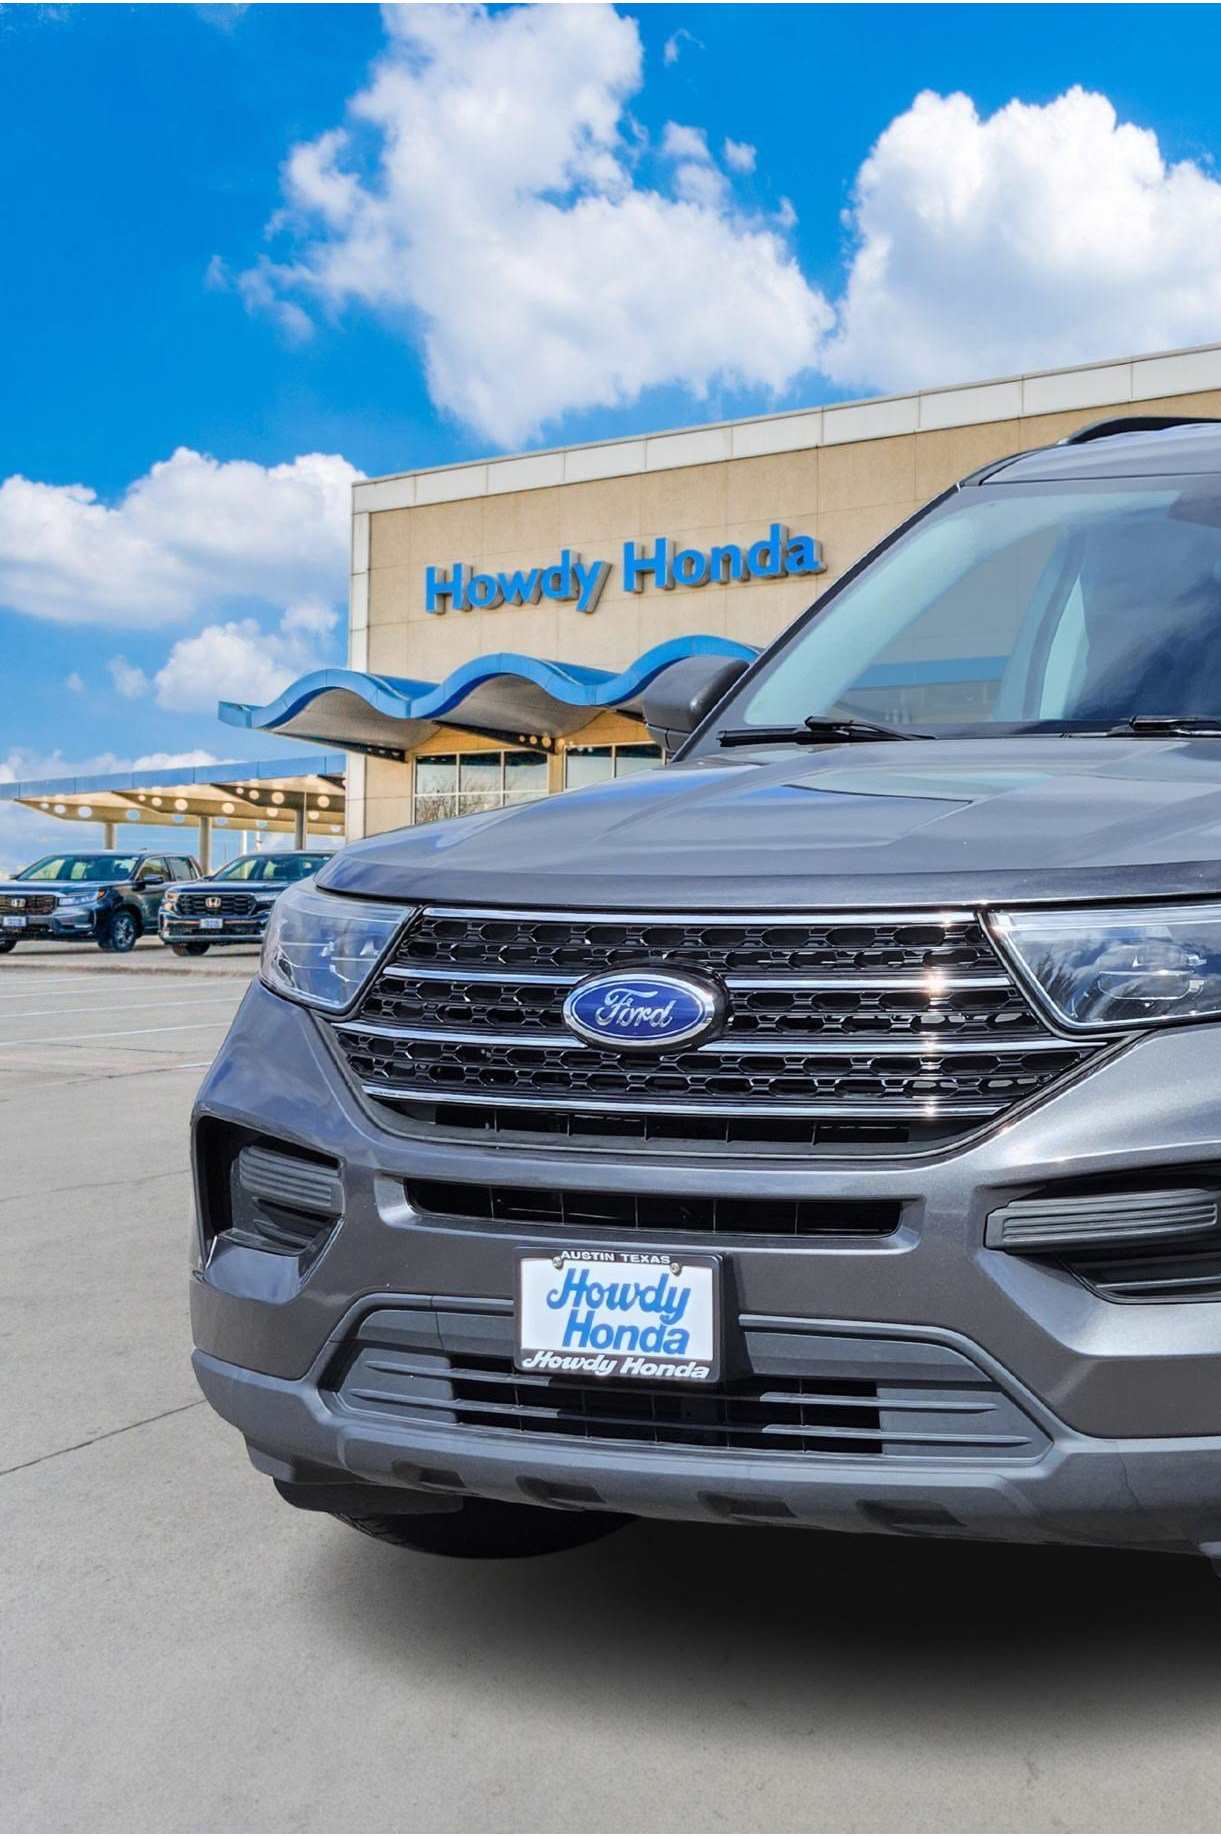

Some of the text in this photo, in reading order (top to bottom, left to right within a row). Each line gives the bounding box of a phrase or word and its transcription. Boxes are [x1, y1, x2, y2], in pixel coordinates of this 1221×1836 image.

[425, 523, 827, 615] Howdy Honda
[595, 988, 676, 1028] Ford
[561, 1250, 671, 1265] AUSTIN TEXAS
[546, 1268, 691, 1325] Howdy
[562, 1309, 690, 1355] Honda
[522, 1351, 710, 1379] Howdy Honda
